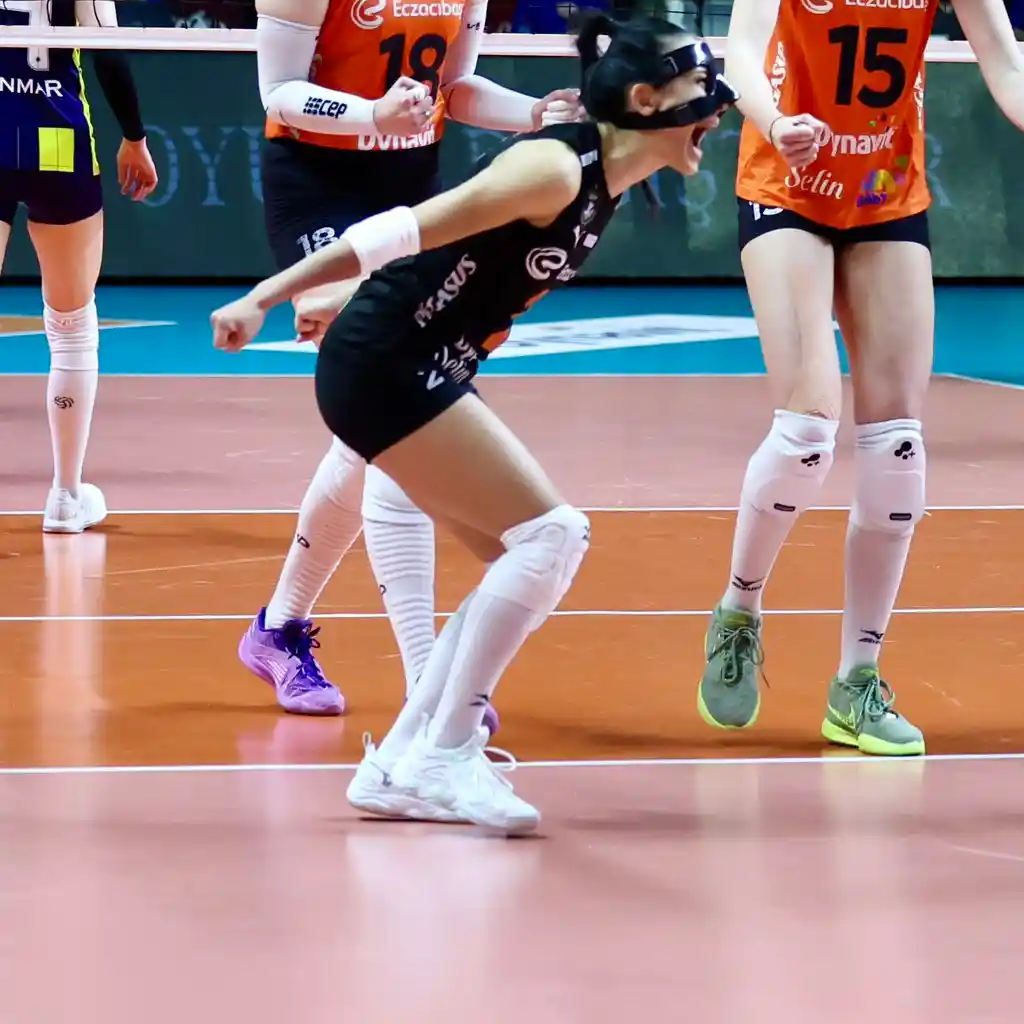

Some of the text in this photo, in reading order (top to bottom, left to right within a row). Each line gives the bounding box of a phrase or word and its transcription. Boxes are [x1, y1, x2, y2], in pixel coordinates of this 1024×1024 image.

[379, 33, 448, 108] 18
[827, 24, 907, 109] 15
[784, 166, 844, 200] Selin
[296, 226, 339, 257] 18
